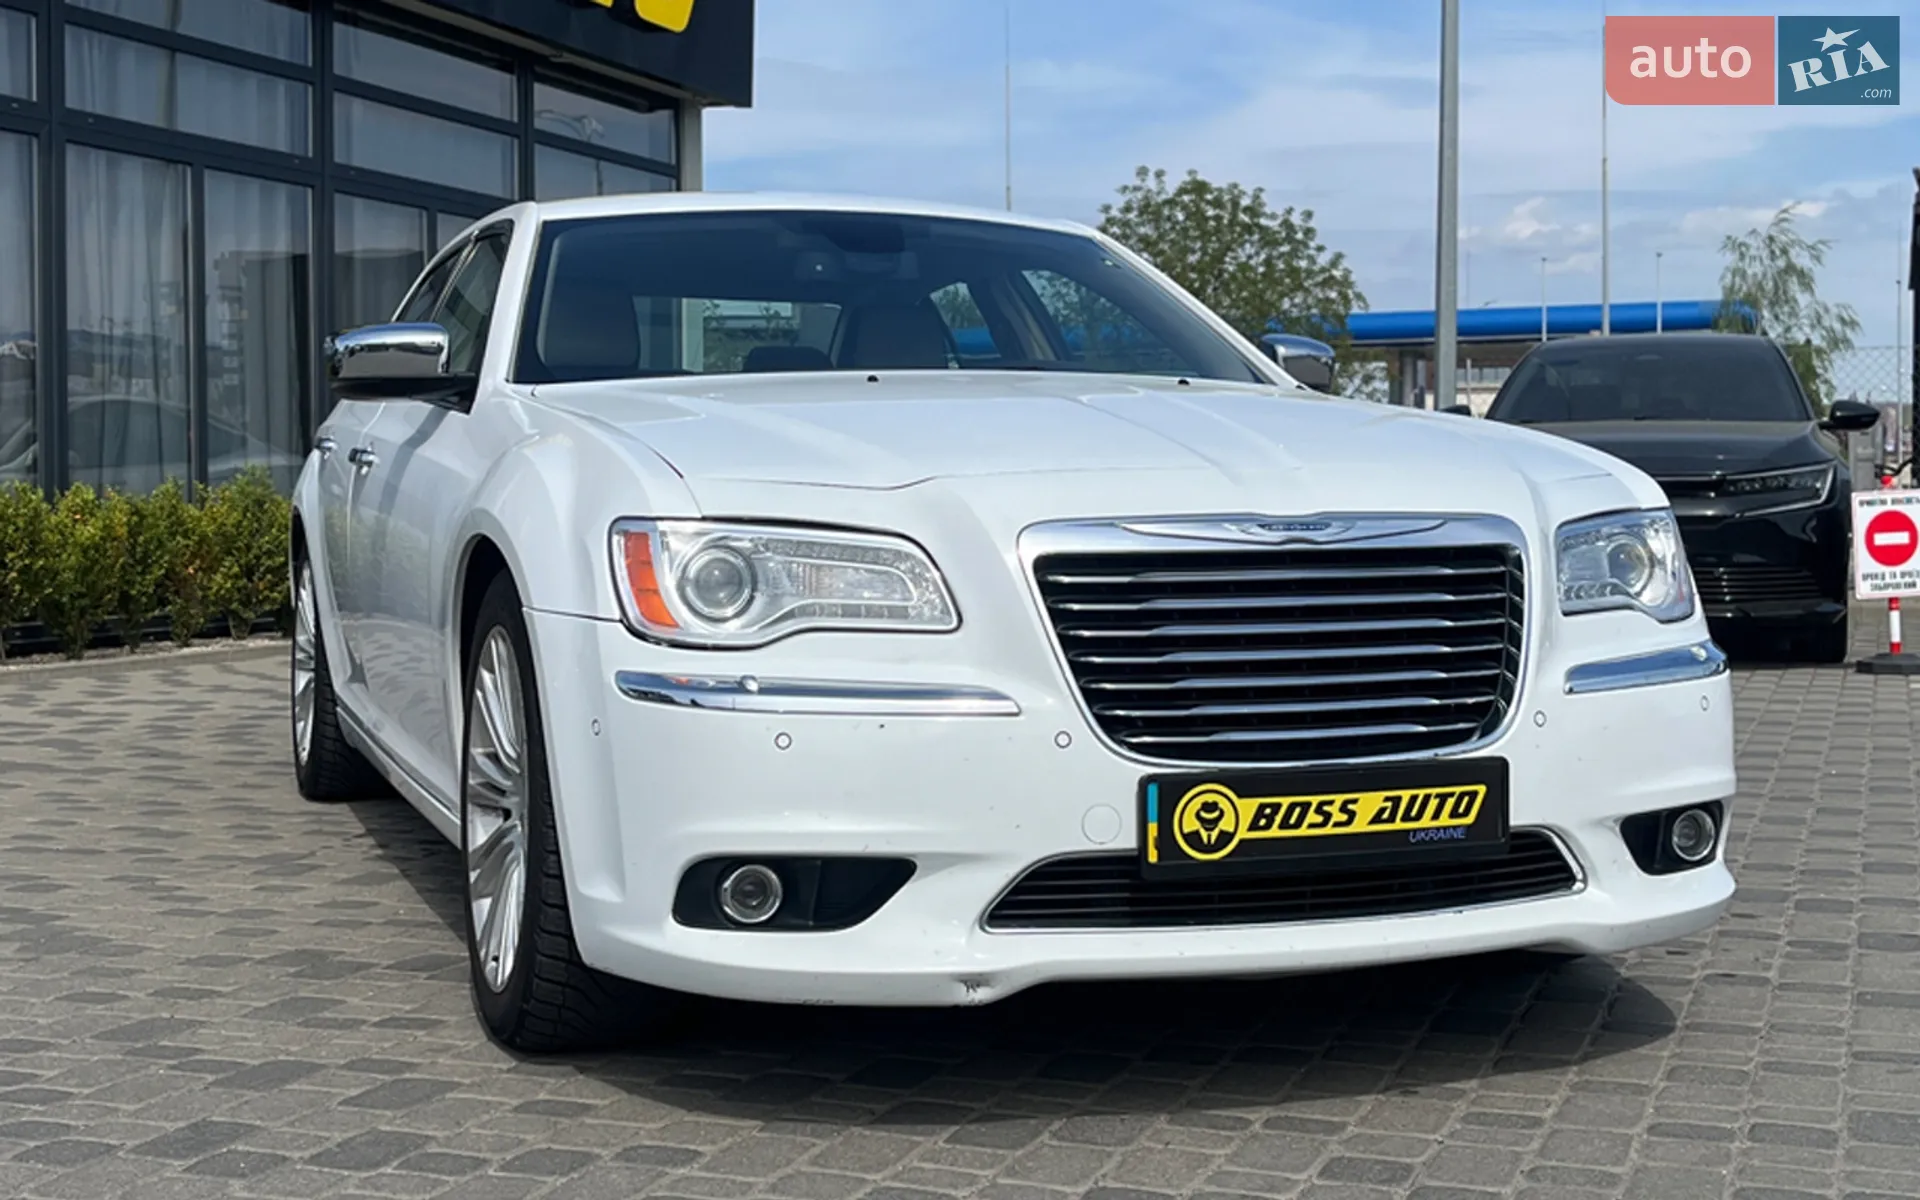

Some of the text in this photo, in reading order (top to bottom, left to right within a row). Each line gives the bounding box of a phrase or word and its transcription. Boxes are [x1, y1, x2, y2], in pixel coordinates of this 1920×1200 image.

[1247, 789, 1479, 832] BOSS AUTO
[1408, 827, 1467, 843] UKRAINE
